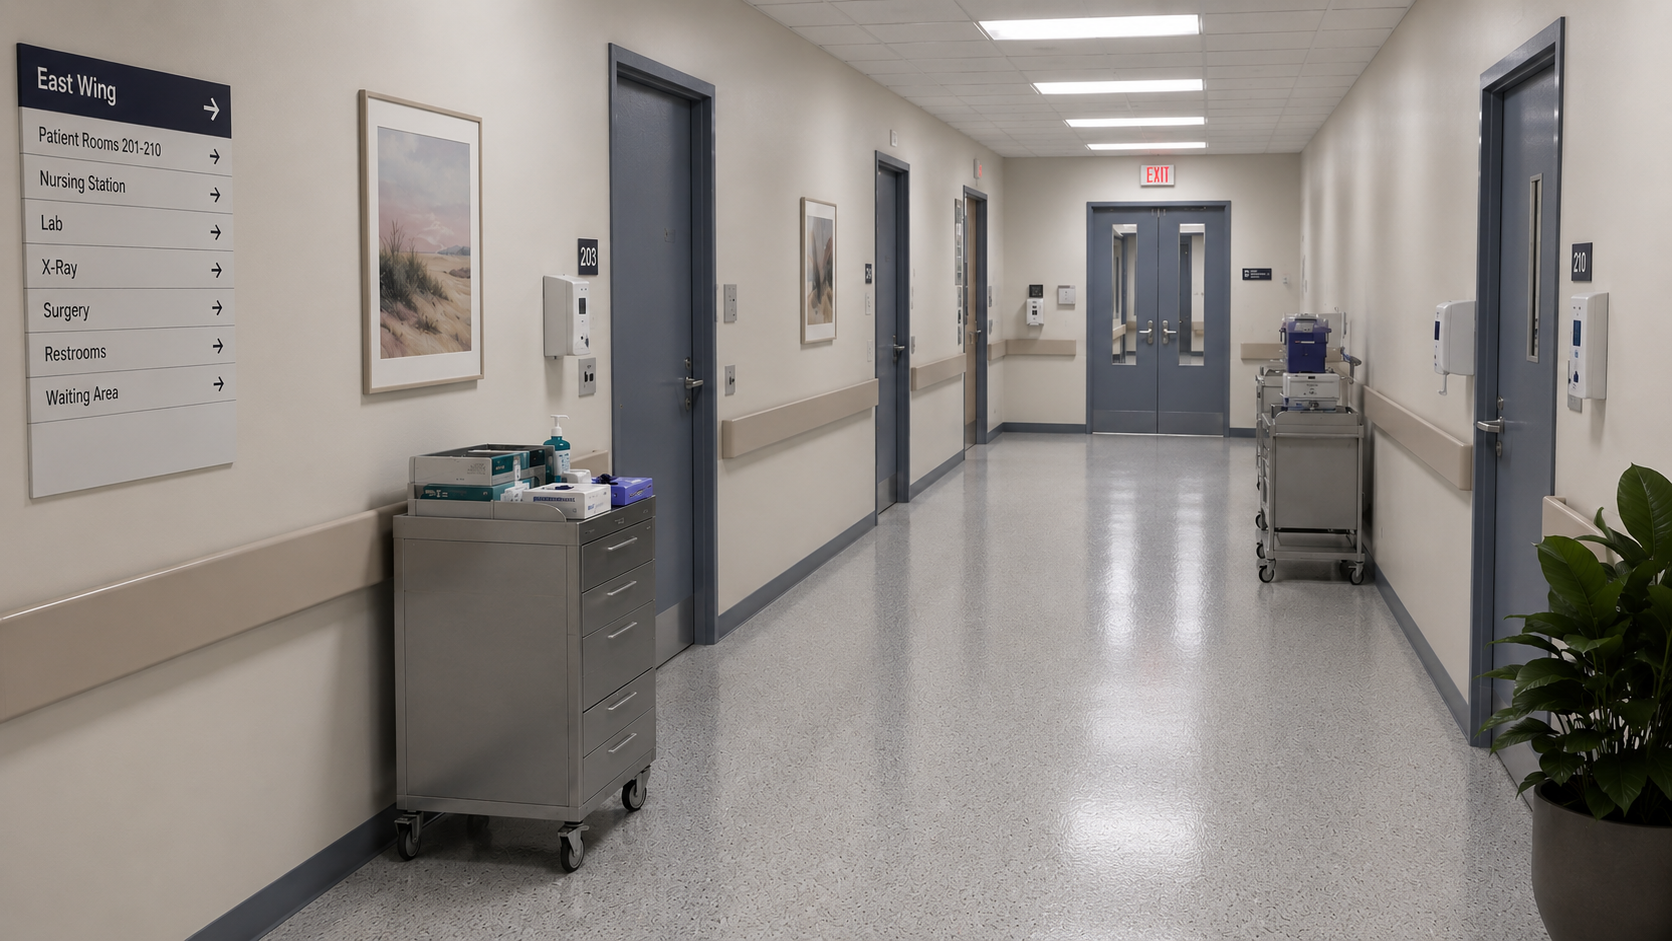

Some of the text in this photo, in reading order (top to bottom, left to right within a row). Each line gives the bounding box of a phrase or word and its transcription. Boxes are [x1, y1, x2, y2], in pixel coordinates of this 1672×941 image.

[37, 66, 117, 106] East Wing
[39, 126, 162, 157] Patient Rooms 201-210
[40, 169, 126, 194] Nursing Station
[1146, 166, 1170, 183] EXIT
[41, 214, 63, 231] Lab
[580, 246, 597, 267] 203
[1573, 252, 1587, 273] 210
[42, 258, 78, 279] X-Ray
[43, 302, 90, 322] Surgery
[45, 346, 107, 362] Restrooms
[46, 386, 119, 407] Waiting Area
